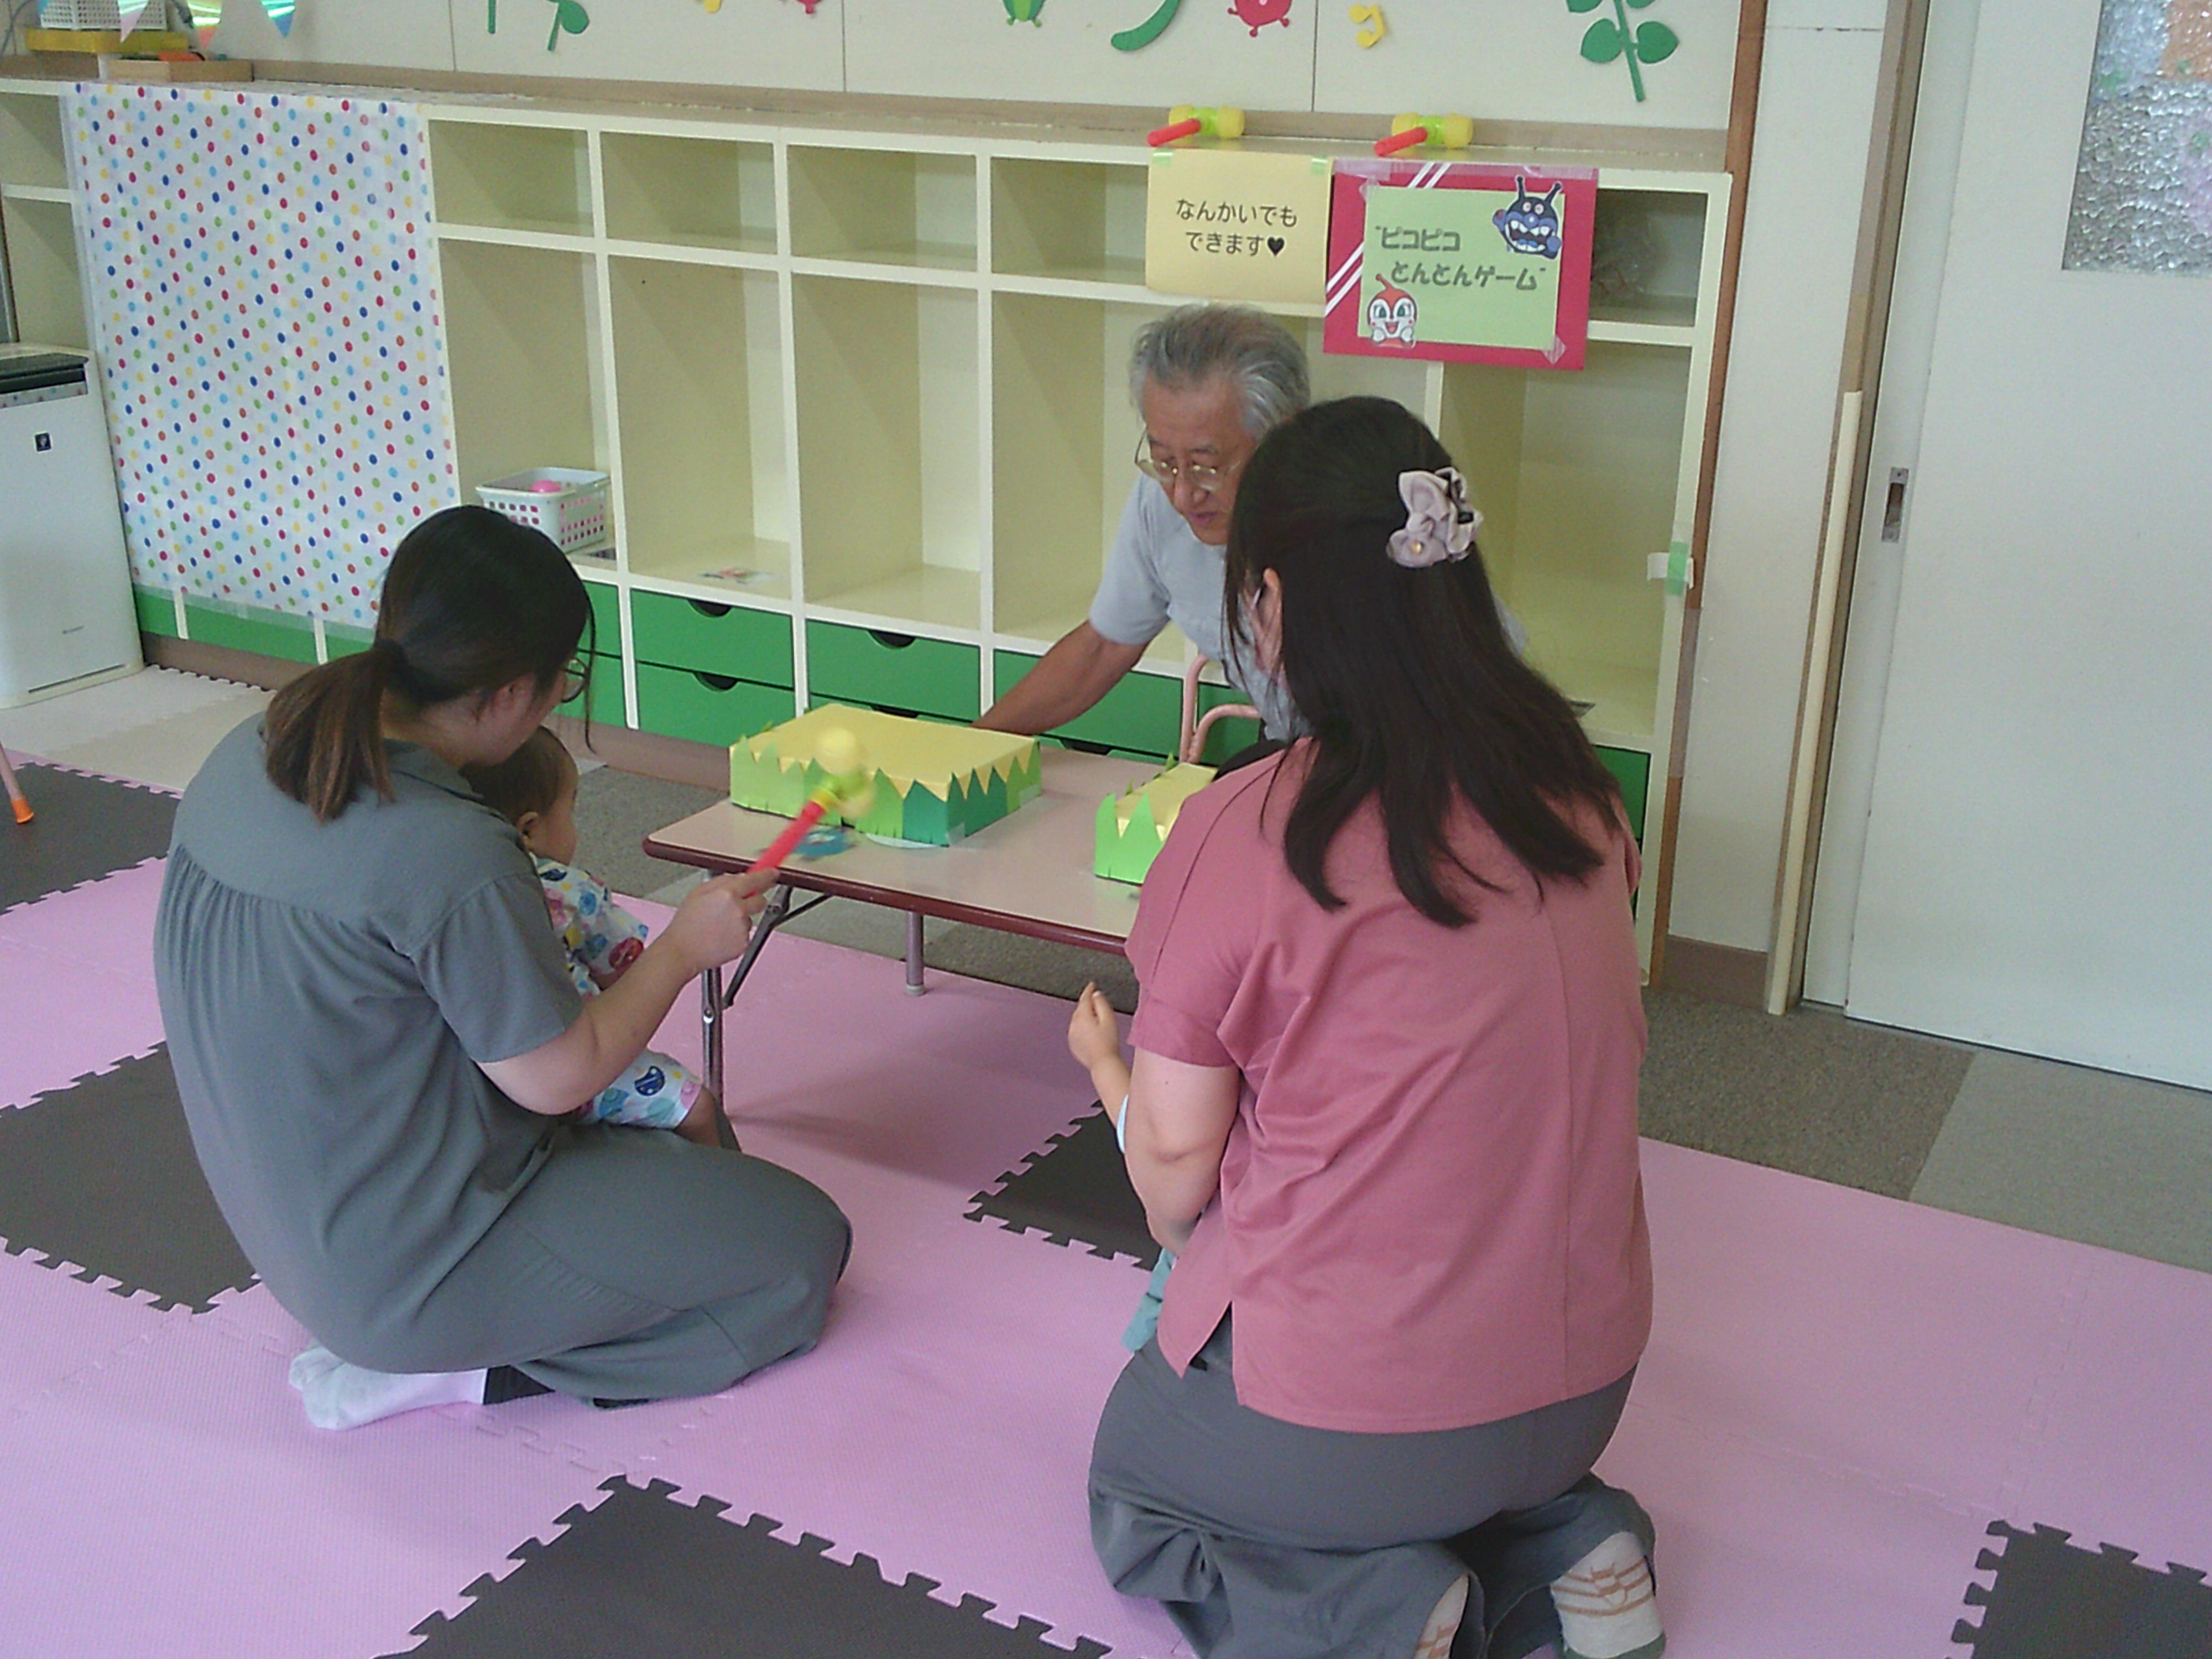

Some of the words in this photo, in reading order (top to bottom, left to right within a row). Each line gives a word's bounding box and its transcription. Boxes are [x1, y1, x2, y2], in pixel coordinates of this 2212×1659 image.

[1176, 199, 1297, 227] なんかいでも
[1185, 231, 1264, 256] できます
